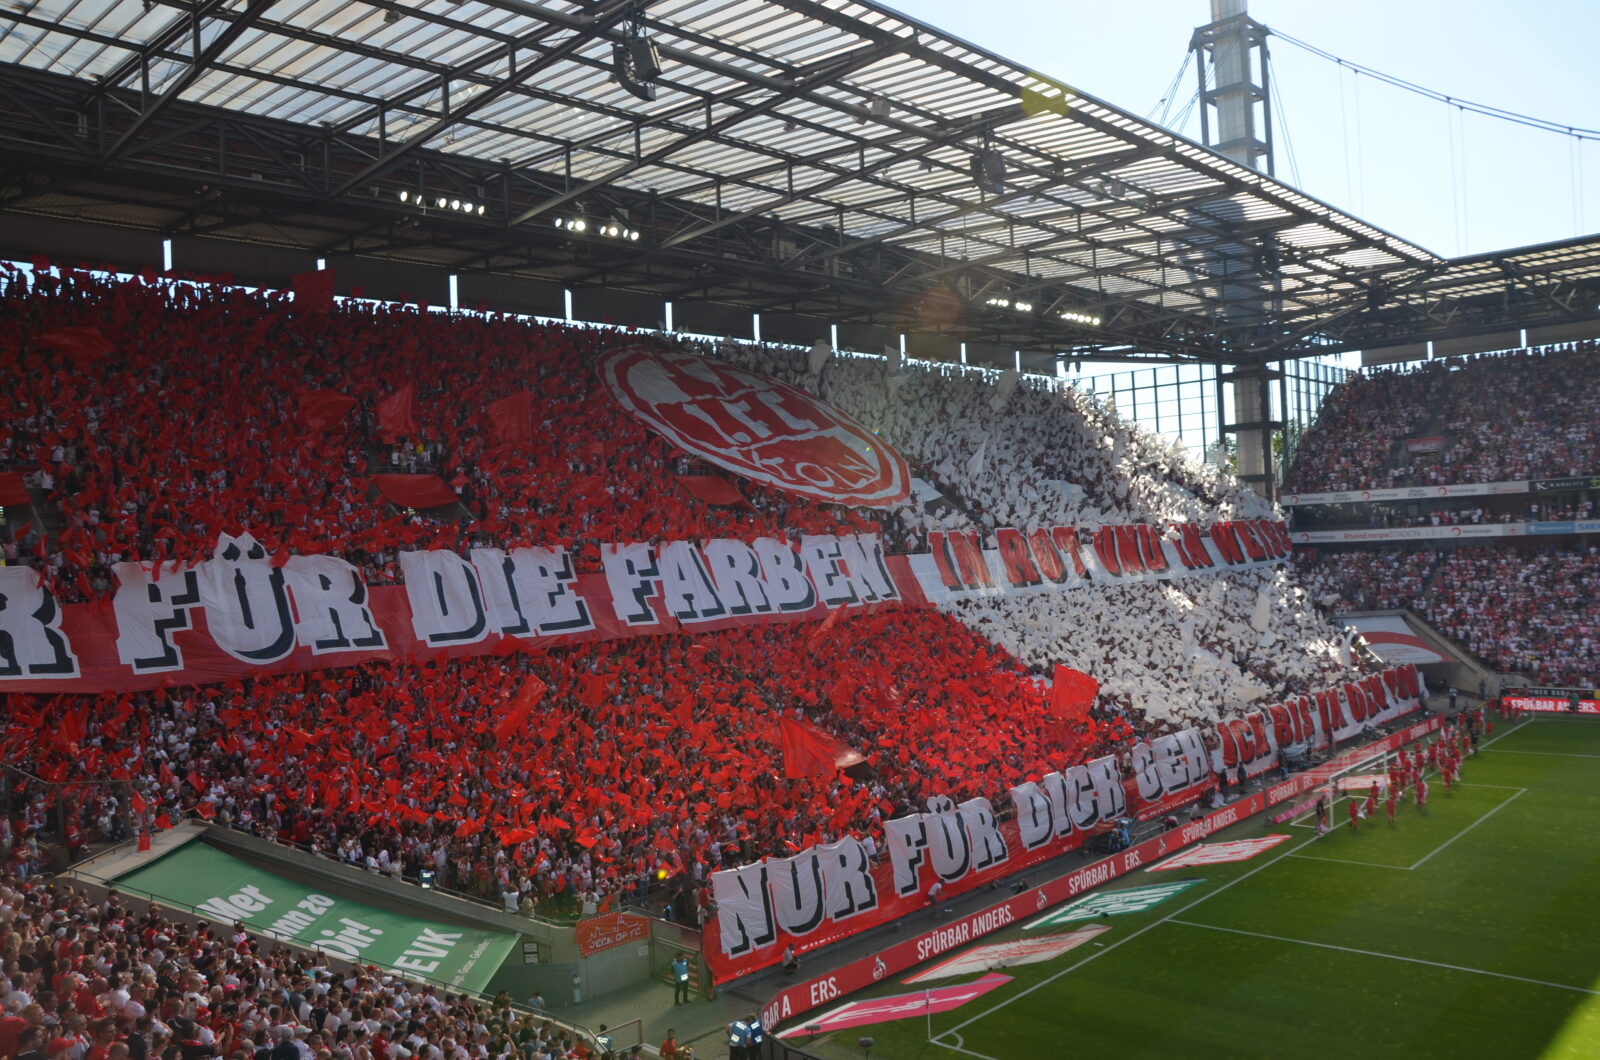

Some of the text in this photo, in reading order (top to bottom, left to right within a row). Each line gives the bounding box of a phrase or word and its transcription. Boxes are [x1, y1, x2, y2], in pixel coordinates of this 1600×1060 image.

[111, 530, 389, 675] FÜR
[400, 545, 596, 648] DIE
[600, 533, 902, 628] FARBEN
[927, 529, 996, 592] IN
[995, 526, 1092, 588] ROT
[1092, 523, 1170, 578] UND
[711, 835, 879, 960] NUR
[883, 794, 1010, 898] FÜR
[1009, 754, 1126, 852] DICH
[1131, 727, 1211, 803] GEH
[1216, 710, 1272, 768] ICH
[1268, 692, 1317, 748] BIS
[1182, 817, 1212, 844] SPÜRBAR
[1068, 863, 1109, 895] SPÜRBAR
[195, 884, 275, 928] Mer
[310, 917, 384, 960] Dir!
[917, 922, 970, 960] SPÜRBAR
[972, 904, 1015, 938] ANDERS.
